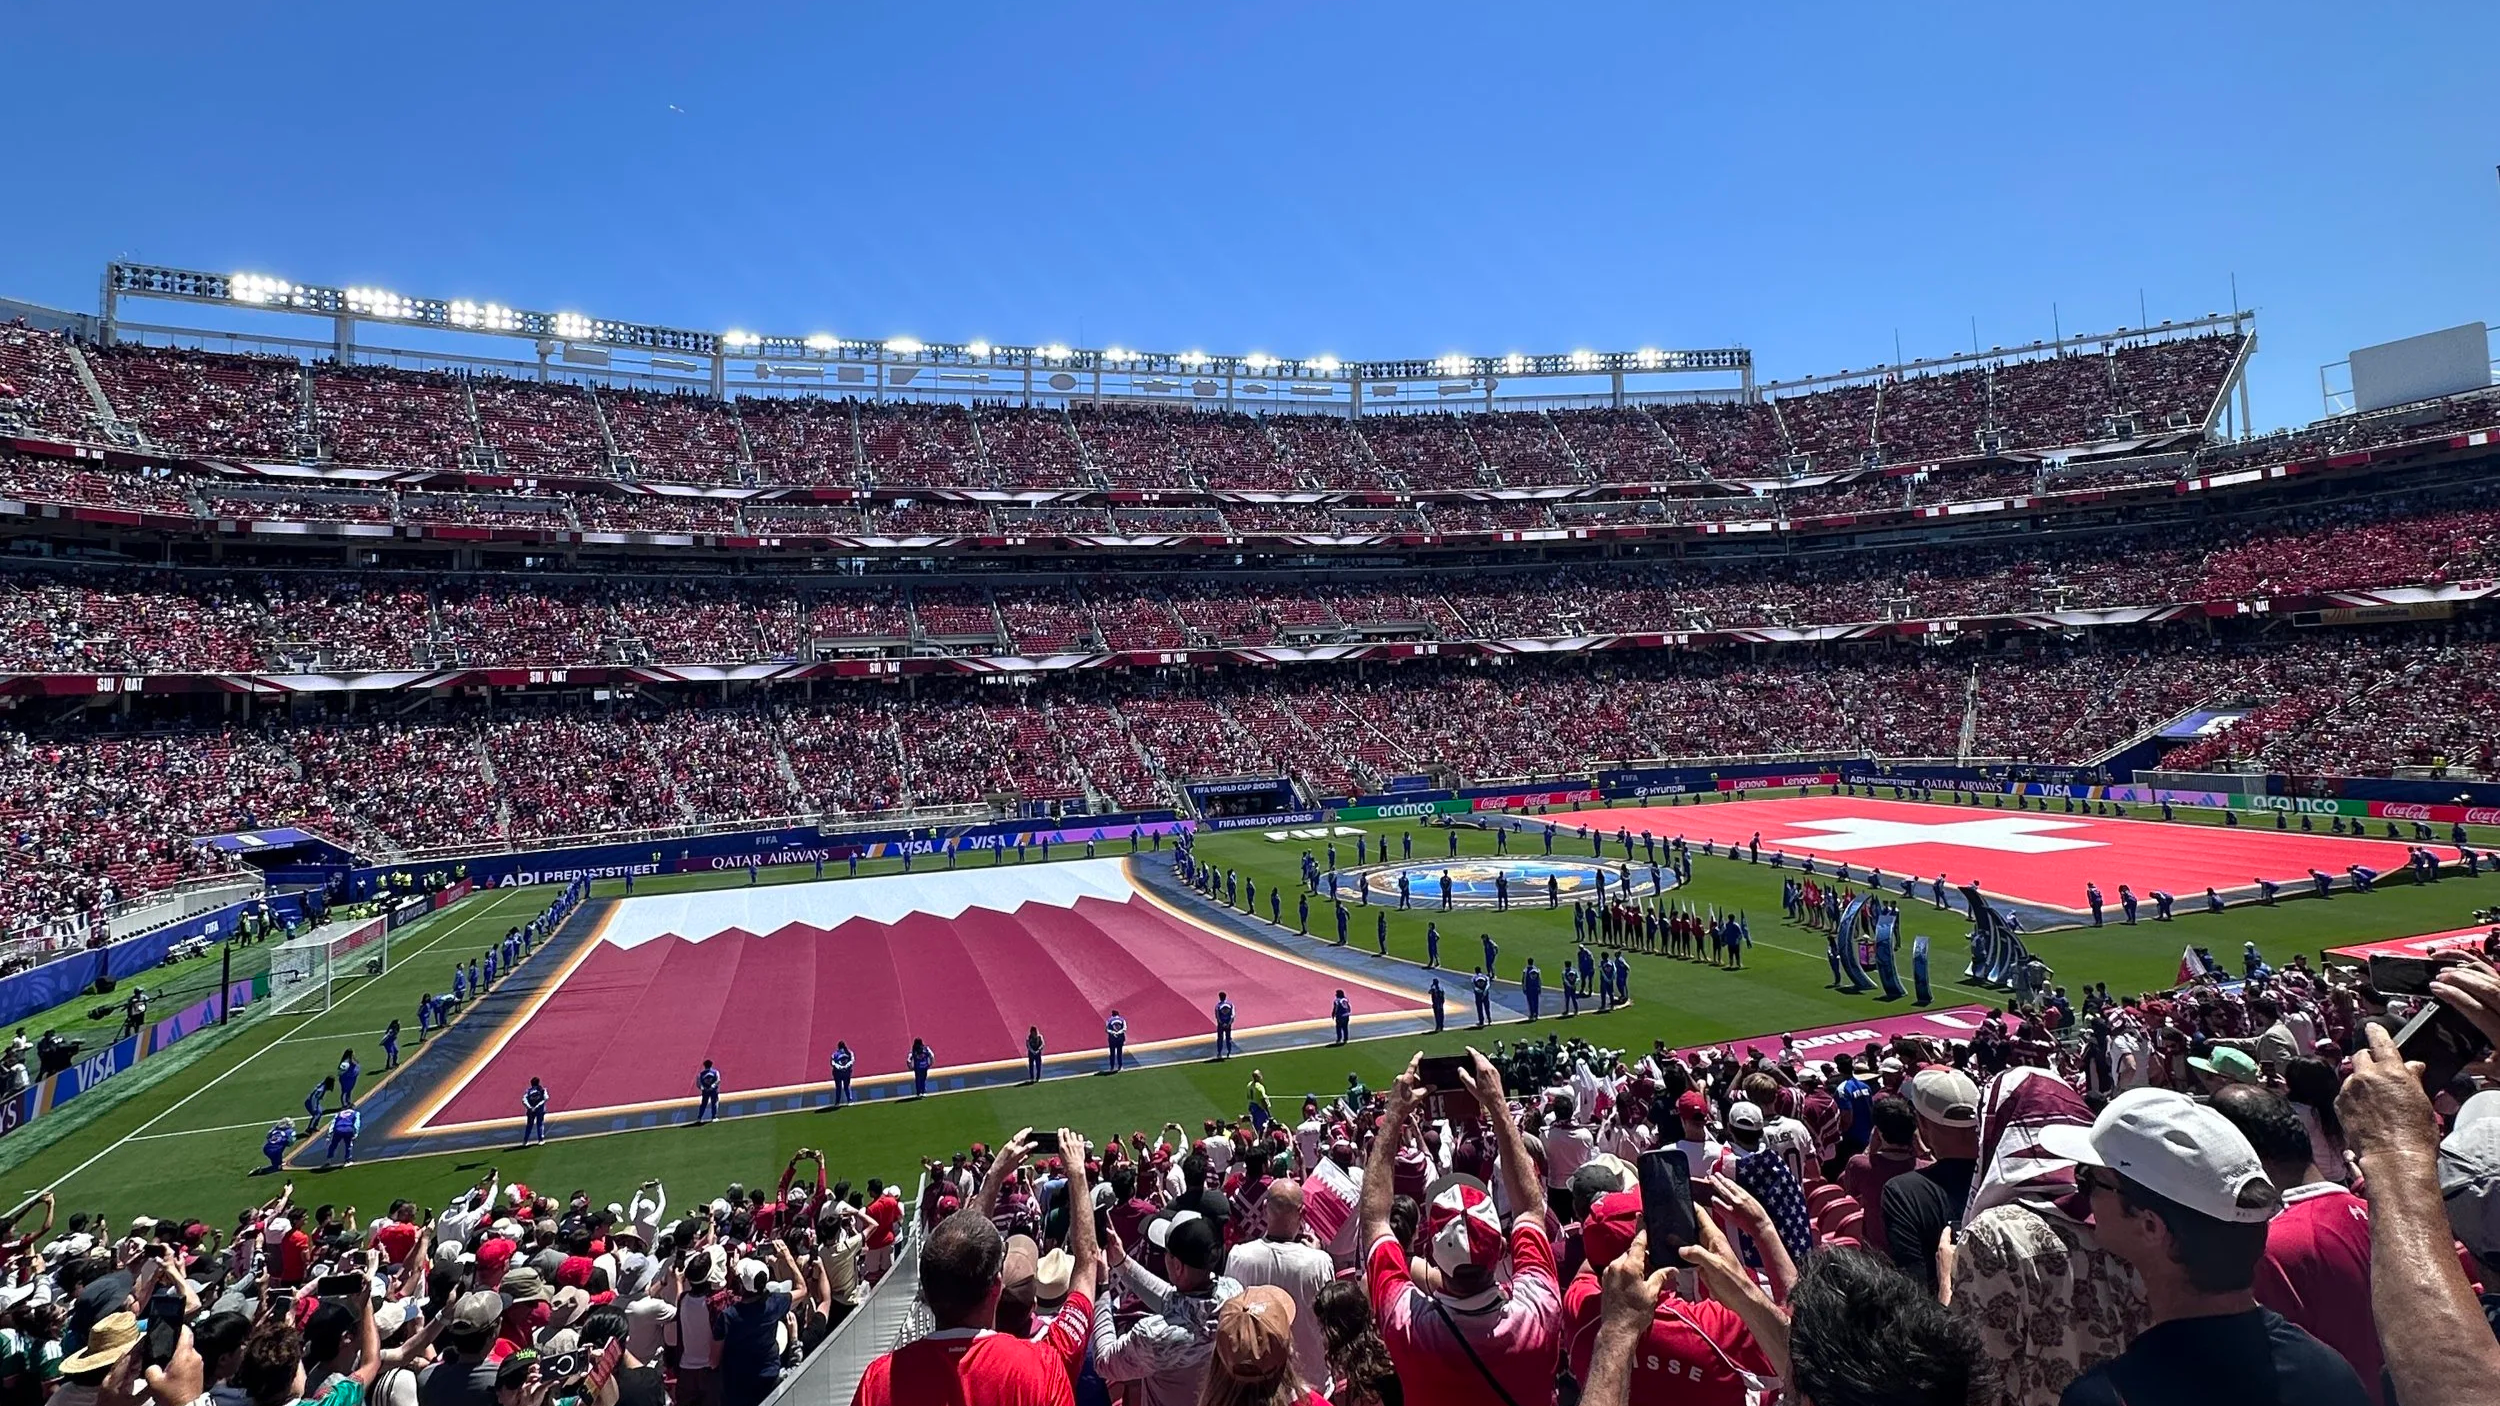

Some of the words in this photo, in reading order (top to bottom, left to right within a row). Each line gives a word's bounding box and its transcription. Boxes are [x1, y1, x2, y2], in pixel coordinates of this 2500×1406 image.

[1732, 778, 1768, 790] Lenovo
[1782, 775, 1820, 787] Lenovo
[1922, 778, 1955, 790] QATAR
[1958, 780, 2003, 793] AIRWAYS
[1649, 784, 1686, 795] HYUNDAI
[2040, 784, 2072, 798] VISA
[1377, 801, 1436, 818] aramco
[755, 836, 778, 846] FIFA
[894, 840, 933, 855] VISA
[711, 854, 762, 871] QATAR
[767, 848, 829, 866] AIRWAYS
[500, 871, 540, 888] ADI
[204, 922, 220, 936] FIFA
[74, 1048, 116, 1093] VISA
